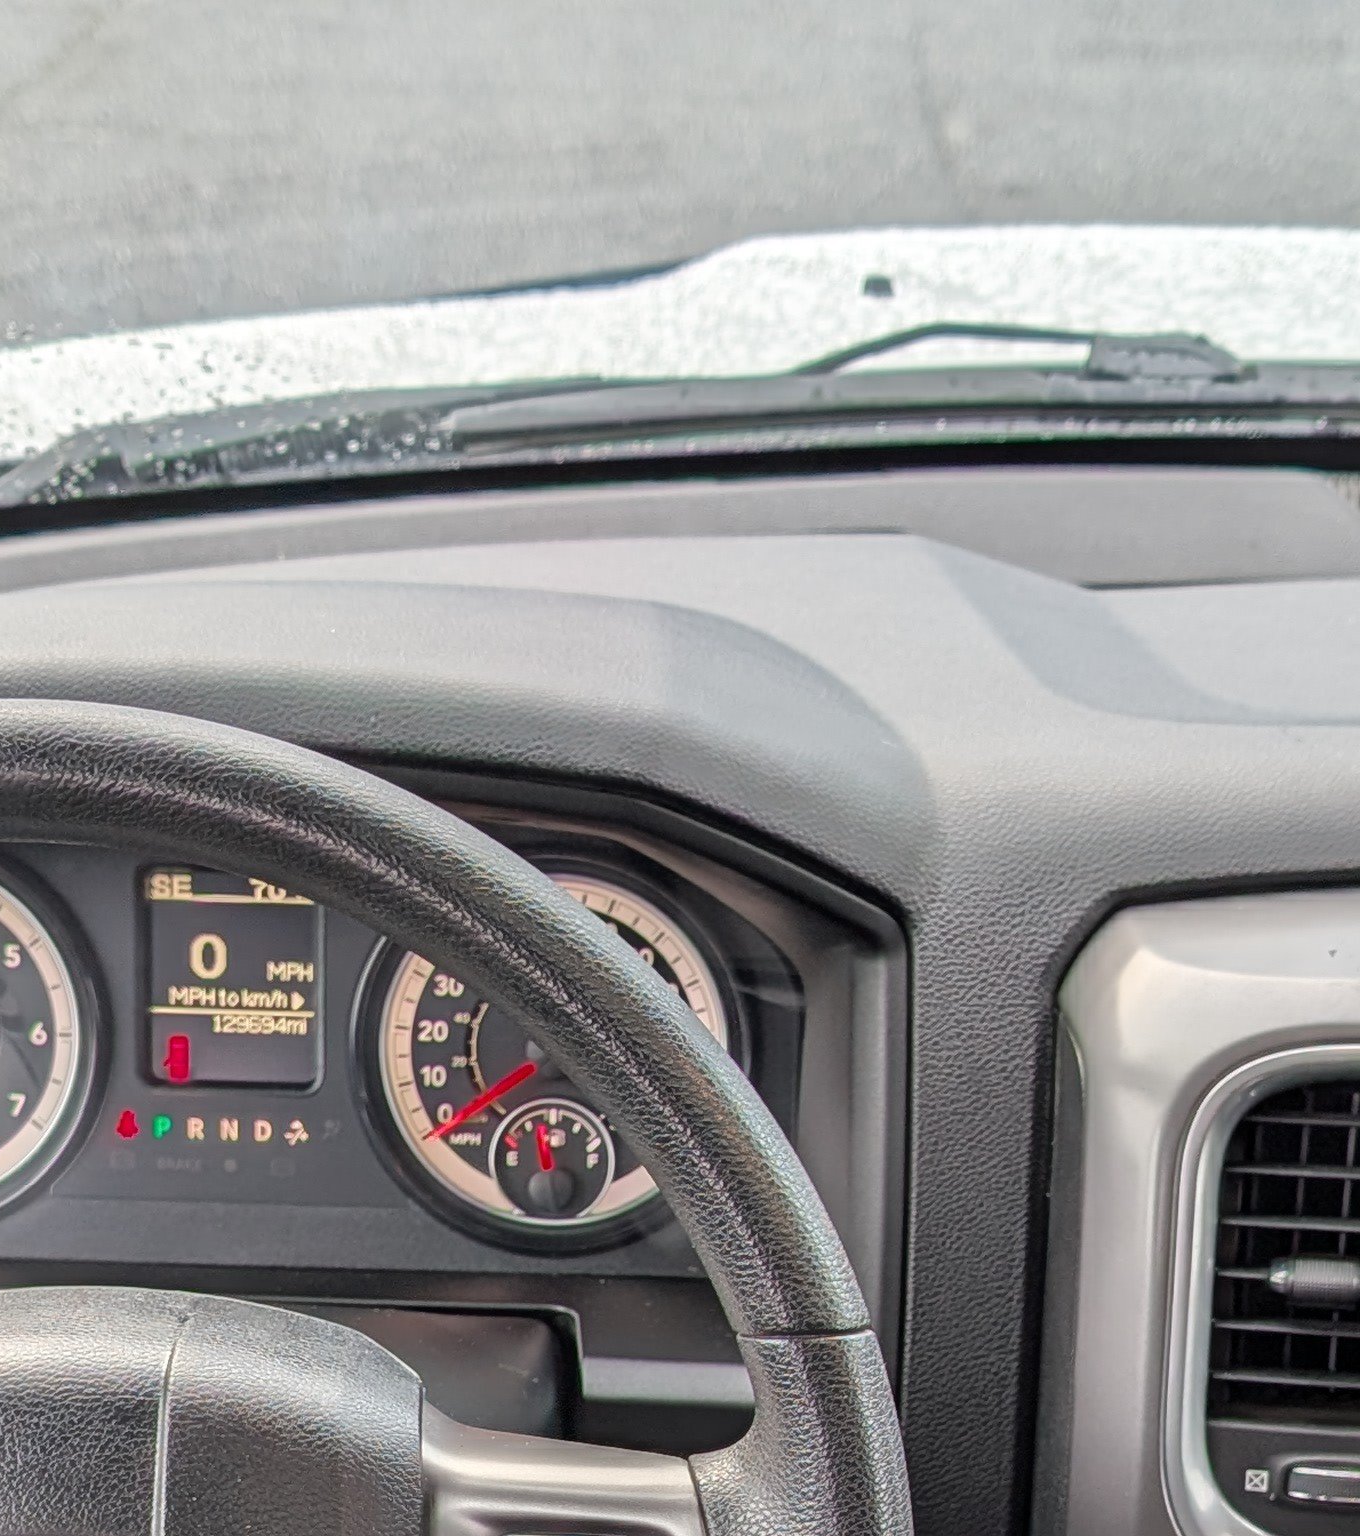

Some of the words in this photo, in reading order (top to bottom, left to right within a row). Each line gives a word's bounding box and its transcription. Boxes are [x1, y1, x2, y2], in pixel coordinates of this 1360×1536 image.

[3, 943, 22, 968] 5
[191, 932, 228, 979] 0
[266, 960, 314, 983] MPH
[167, 985, 217, 1006] MPH
[434, 973, 465, 998] 30
[28, 1020, 48, 1046] 6
[417, 1020, 450, 1043] 20
[419, 1065, 448, 1088] 10
[7, 1093, 26, 1118] 7
[152, 1114, 172, 1139] P
[186, 1116, 205, 1141] R
[219, 1117, 240, 1142] N
[253, 1119, 273, 1143] D
